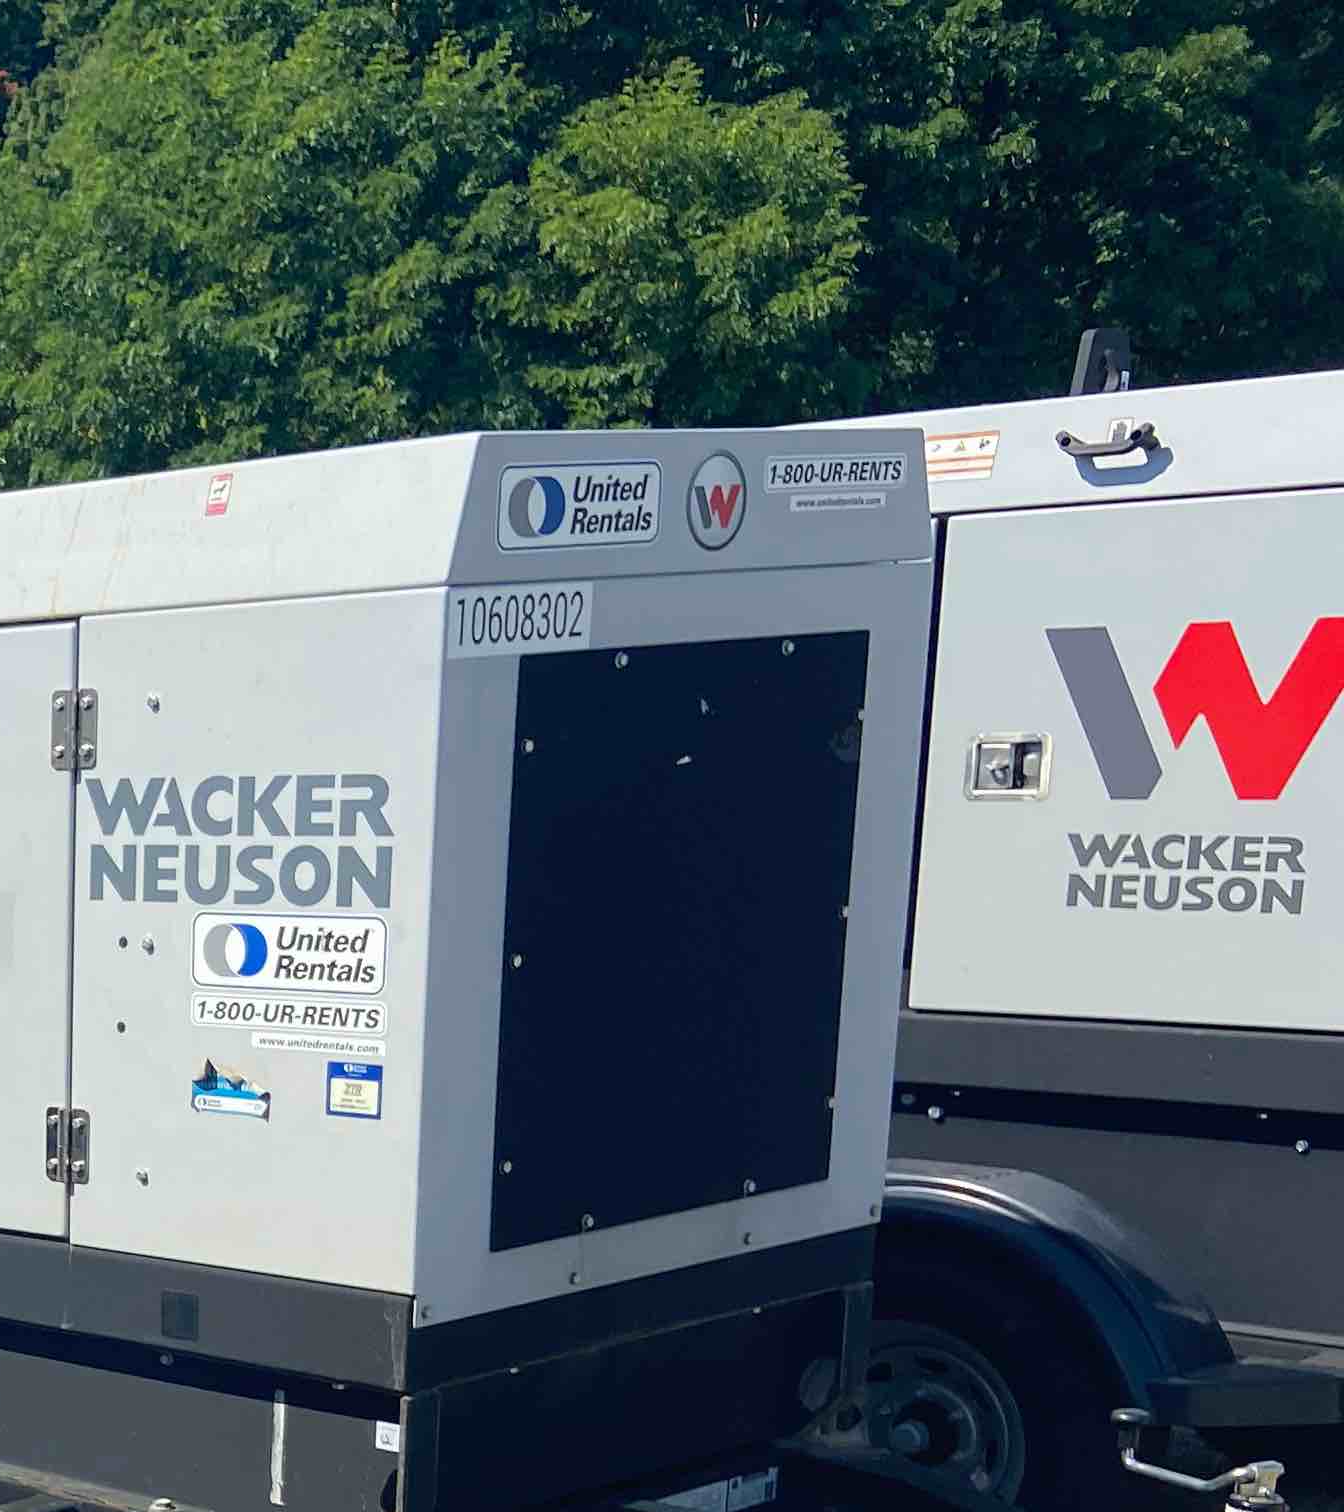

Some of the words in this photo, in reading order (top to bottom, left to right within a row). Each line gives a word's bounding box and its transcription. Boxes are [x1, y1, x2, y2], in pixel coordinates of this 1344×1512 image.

[572, 473, 648, 503] United
[770, 460, 902, 485] 1-800-UR-RENTS
[569, 502, 653, 534] Rentals
[456, 590, 584, 646] 10608302
[85, 773, 395, 837] WACKER
[1067, 832, 1306, 873] WACKER
[88, 844, 393, 909] NEUSON
[1065, 874, 1305, 915] NEUSON
[276, 926, 370, 954] United
[274, 955, 376, 983] Rentals
[197, 1000, 381, 1030] 1-800-UR-RENTS
[258, 1037, 380, 1055] www.unitedrentals.com
